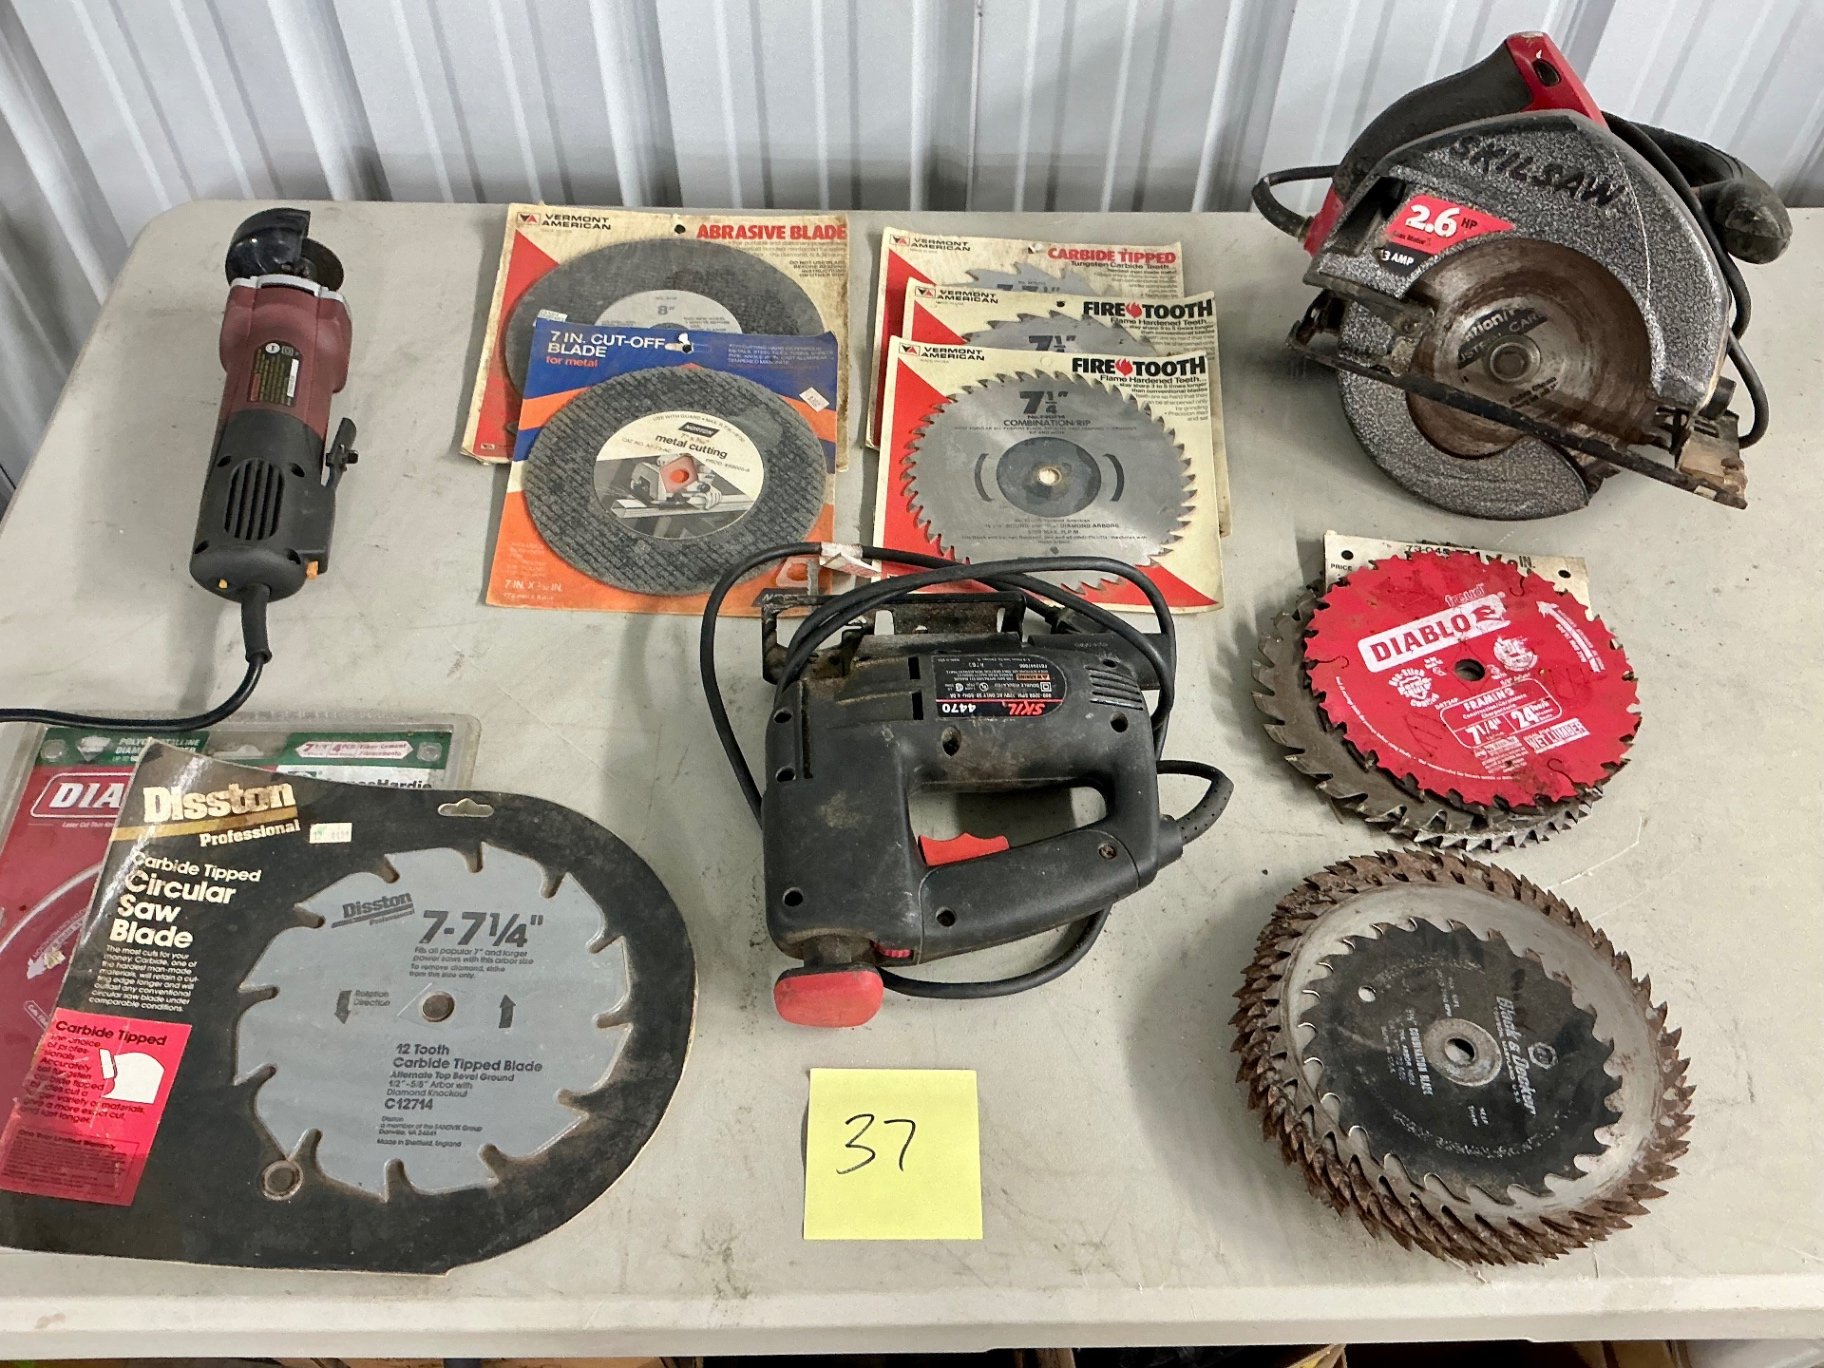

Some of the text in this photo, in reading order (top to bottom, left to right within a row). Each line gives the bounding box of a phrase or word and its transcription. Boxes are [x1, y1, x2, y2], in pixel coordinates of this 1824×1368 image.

[1449, 135, 1627, 207] SKILSAW
[545, 213, 610, 223] VERMONT
[1404, 203, 1479, 239] 2.6 HP
[541, 221, 612, 231] AMERICAN
[696, 223, 848, 240] ABRASIVE BLADE
[911, 242, 971, 252] AMERICAN
[913, 238, 969, 247] VERMONT
[1047, 247, 1177, 264] CARBIDE TIPPED
[1391, 251, 1415, 266] AMP
[1071, 260, 1109, 268] Tungsten
[1109, 261, 1144, 269] Carbide
[937, 294, 999, 304] AMERICAN
[939, 289, 997, 298] VERMONT
[1083, 299, 1213, 319] FIRE TOOTH
[1110, 317, 1137, 325] Flame
[1139, 319, 1182, 327] Hardened
[550, 331, 666, 349] 7 IN. CUT-OFF
[547, 342, 607, 358] BLADE
[921, 352, 985, 361] AMERICAN
[924, 346, 983, 355] VERMONT
[545, 355, 598, 369] for metal
[1071, 355, 1206, 377] FIRE TOOTH
[1129, 376, 1173, 384] Hardened
[683, 424, 715, 436] NORTON
[655, 433, 728, 460] metal cutting
[1330, 562, 1353, 572] PRICE
[1518, 555, 1536, 569] IN.
[1444, 583, 1485, 608] freud
[1369, 613, 1472, 663] DIABLO
[1462, 687, 1515, 712] FRAMING
[941, 703, 977, 713] 4470
[1007, 702, 1046, 716] SKIL
[1510, 704, 1541, 730] 24
[1526, 721, 1586, 751] WET LUMBER
[143, 782, 297, 824] Disston
[199, 818, 301, 848] Professional
[131, 850, 262, 883] Carbide Tipped
[125, 868, 237, 904] Circular
[117, 893, 182, 923] Saw
[342, 892, 413, 919] Disston
[109, 918, 194, 949] Blade
[106, 944, 121, 953] The
[121, 947, 141, 955] most
[142, 949, 158, 957] cuts
[159, 950, 171, 958] for
[439, 947, 474, 957] popular
[501, 950, 528, 958] larger
[494, 957, 517, 965] arbor
[116, 962, 192, 975] hardest man-made
[112, 977, 135, 986] edge
[136, 979, 163, 988] longer
[152, 973, 176, 981] retain
[91, 990, 121, 999] circular
[140, 994, 165, 1003] blade
[166, 997, 191, 1005] under
[121, 985, 192, 998] any conventional
[354, 989, 390, 998] Rotation
[88, 996, 140, 1008] comparable
[352, 998, 391, 1007] Direction
[55, 1020, 167, 1046] Carbide Tipped
[396, 1043, 450, 1056] 12 Tooth
[1409, 1027, 1429, 1075] COMBINATION
[1496, 995, 1537, 1117] Black Decker
[40, 1057, 92, 1072] Accurately
[392, 1057, 543, 1072] Carbide Tipped Blade
[389, 1070, 515, 1082] Alternate Top Bevel Ground
[72, 1080, 105, 1091] tipped
[429, 1080, 474, 1090] Arbor with
[386, 1088, 468, 1098] Diamond Knockout
[54, 1102, 80, 1113] more
[57, 1096, 89, 1107] variety
[384, 1097, 434, 1111] C12714
[835, 1112, 917, 1175] 37
